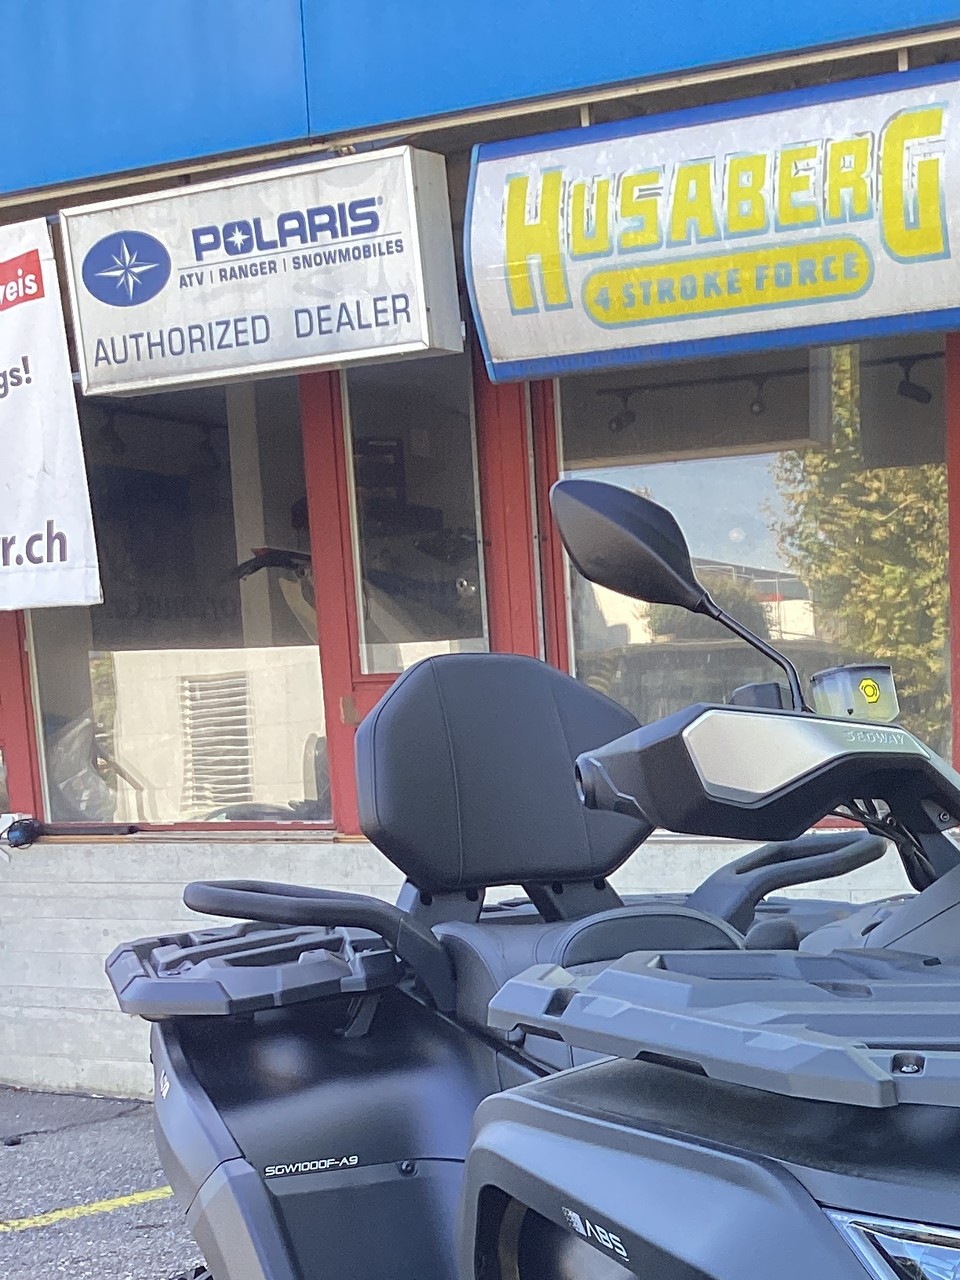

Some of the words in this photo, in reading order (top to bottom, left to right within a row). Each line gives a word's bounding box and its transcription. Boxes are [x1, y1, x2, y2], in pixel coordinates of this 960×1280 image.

[503, 101, 951, 316] HUSABERG
[178, 271, 205, 289] ATV
[219, 259, 278, 282] RANGER
[292, 239, 404, 271] SNOWMOBILES
[594, 285, 610, 311] 4
[621, 260, 743, 308] STROKE
[754, 251, 861, 292] FORCE
[94, 314, 271, 368] AUTHORIZED
[294, 293, 411, 339] DEALER
[0, 519, 68, 567] r.ch
[264, 1155, 359, 1177] SGW1000F-A9
